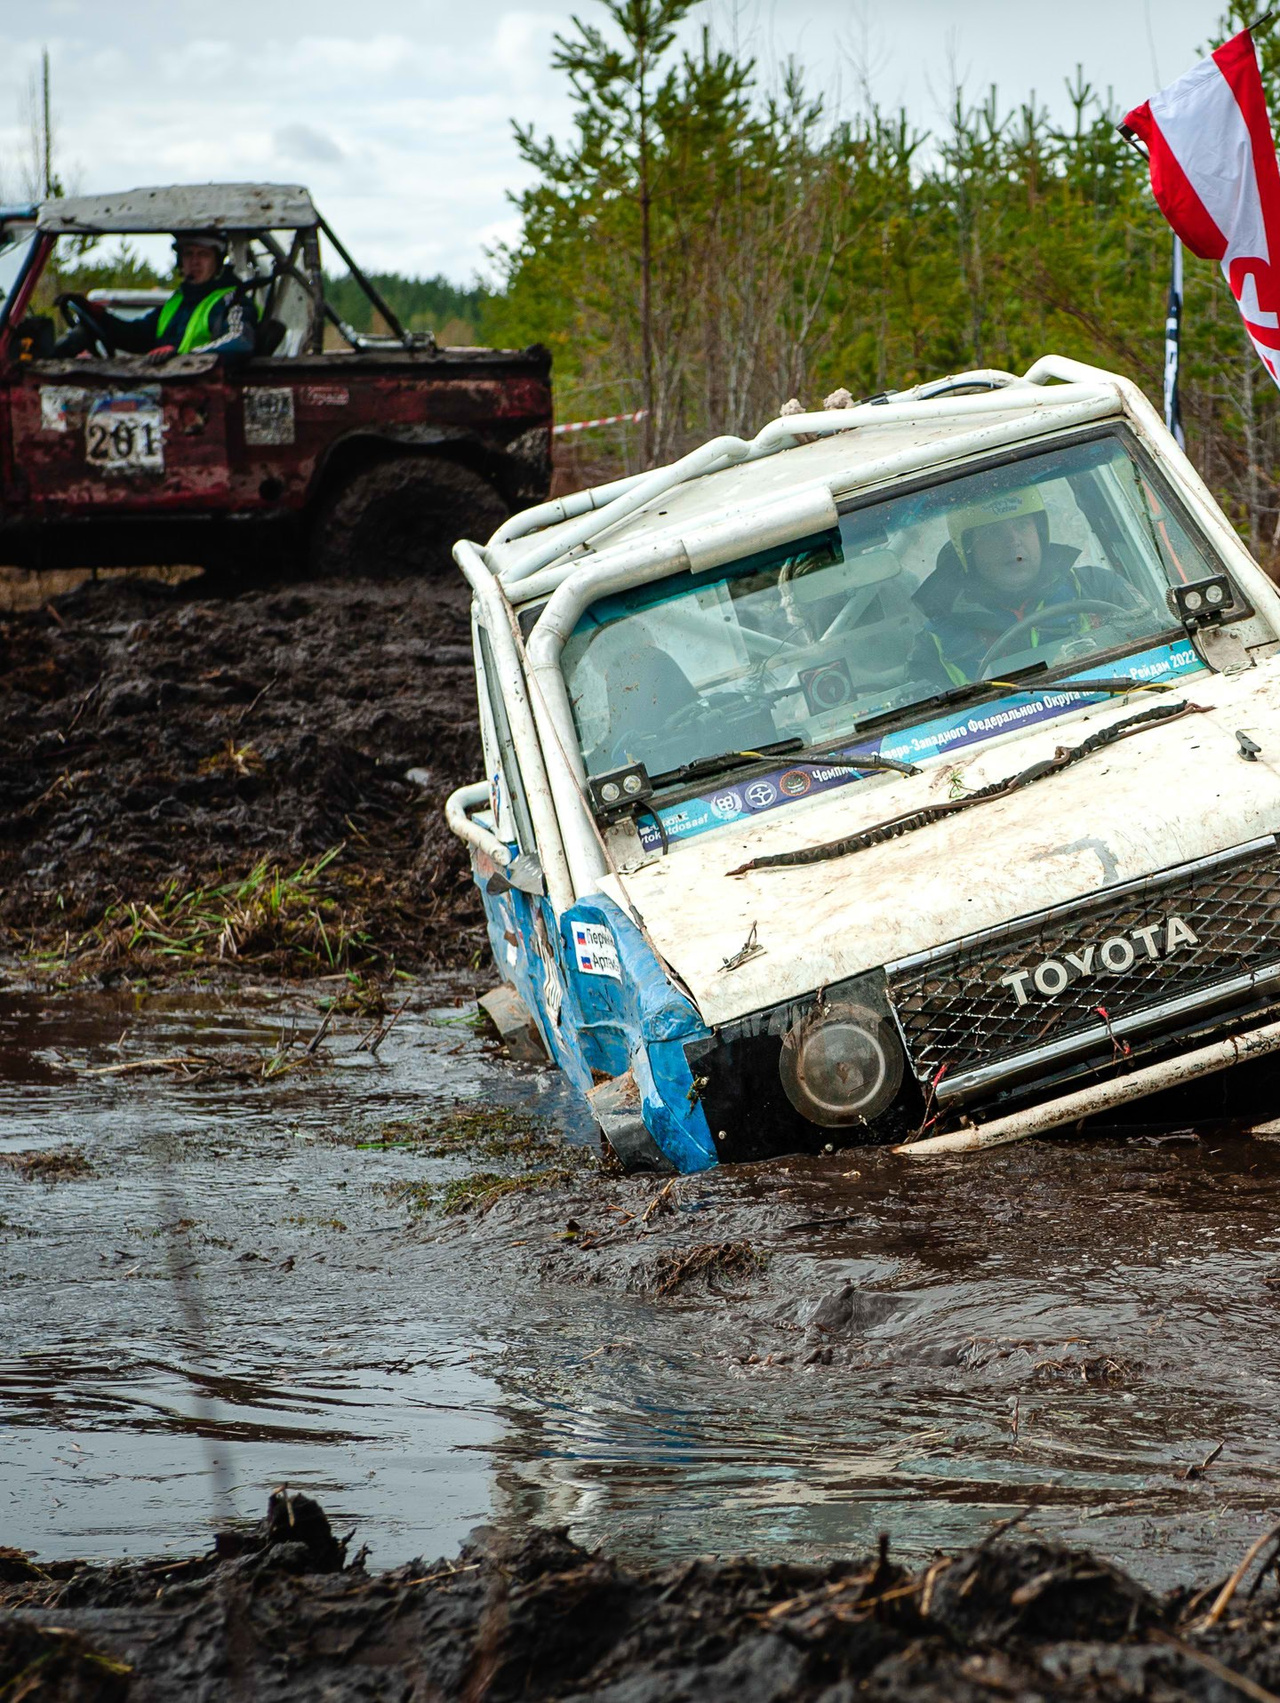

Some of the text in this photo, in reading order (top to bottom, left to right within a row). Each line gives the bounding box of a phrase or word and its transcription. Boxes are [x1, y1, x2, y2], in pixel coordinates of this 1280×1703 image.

[88, 422, 157, 459] 201
[967, 700, 1044, 734] Федерального
[1043, 690, 1081, 708] Округа
[1169, 649, 1198, 668] 2022
[1001, 916, 1200, 1007] TOYOTA
